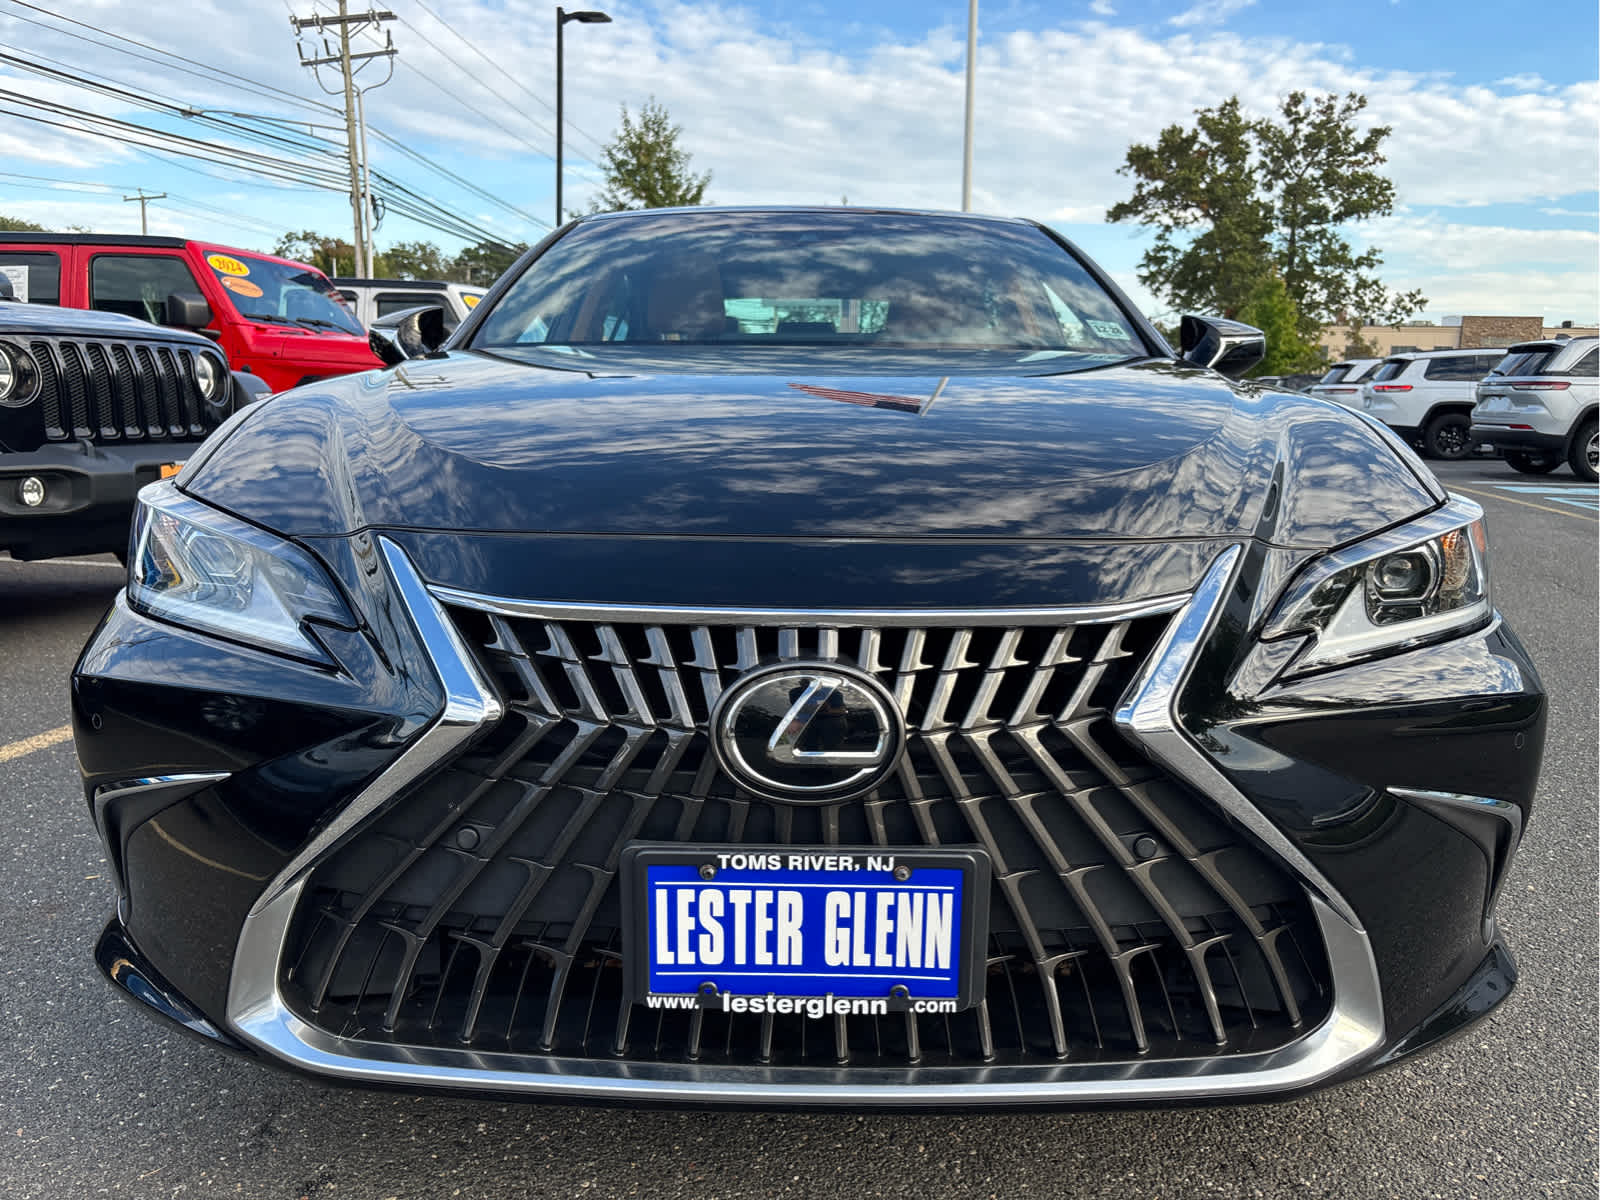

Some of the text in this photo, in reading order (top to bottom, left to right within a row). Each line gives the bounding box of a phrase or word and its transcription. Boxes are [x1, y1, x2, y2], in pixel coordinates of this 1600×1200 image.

[718, 855, 895, 872] TOMS RIVER, NJ
[655, 889, 954, 970] LESTER GLENN
[647, 995, 957, 1019] www. lesterglenn .com
